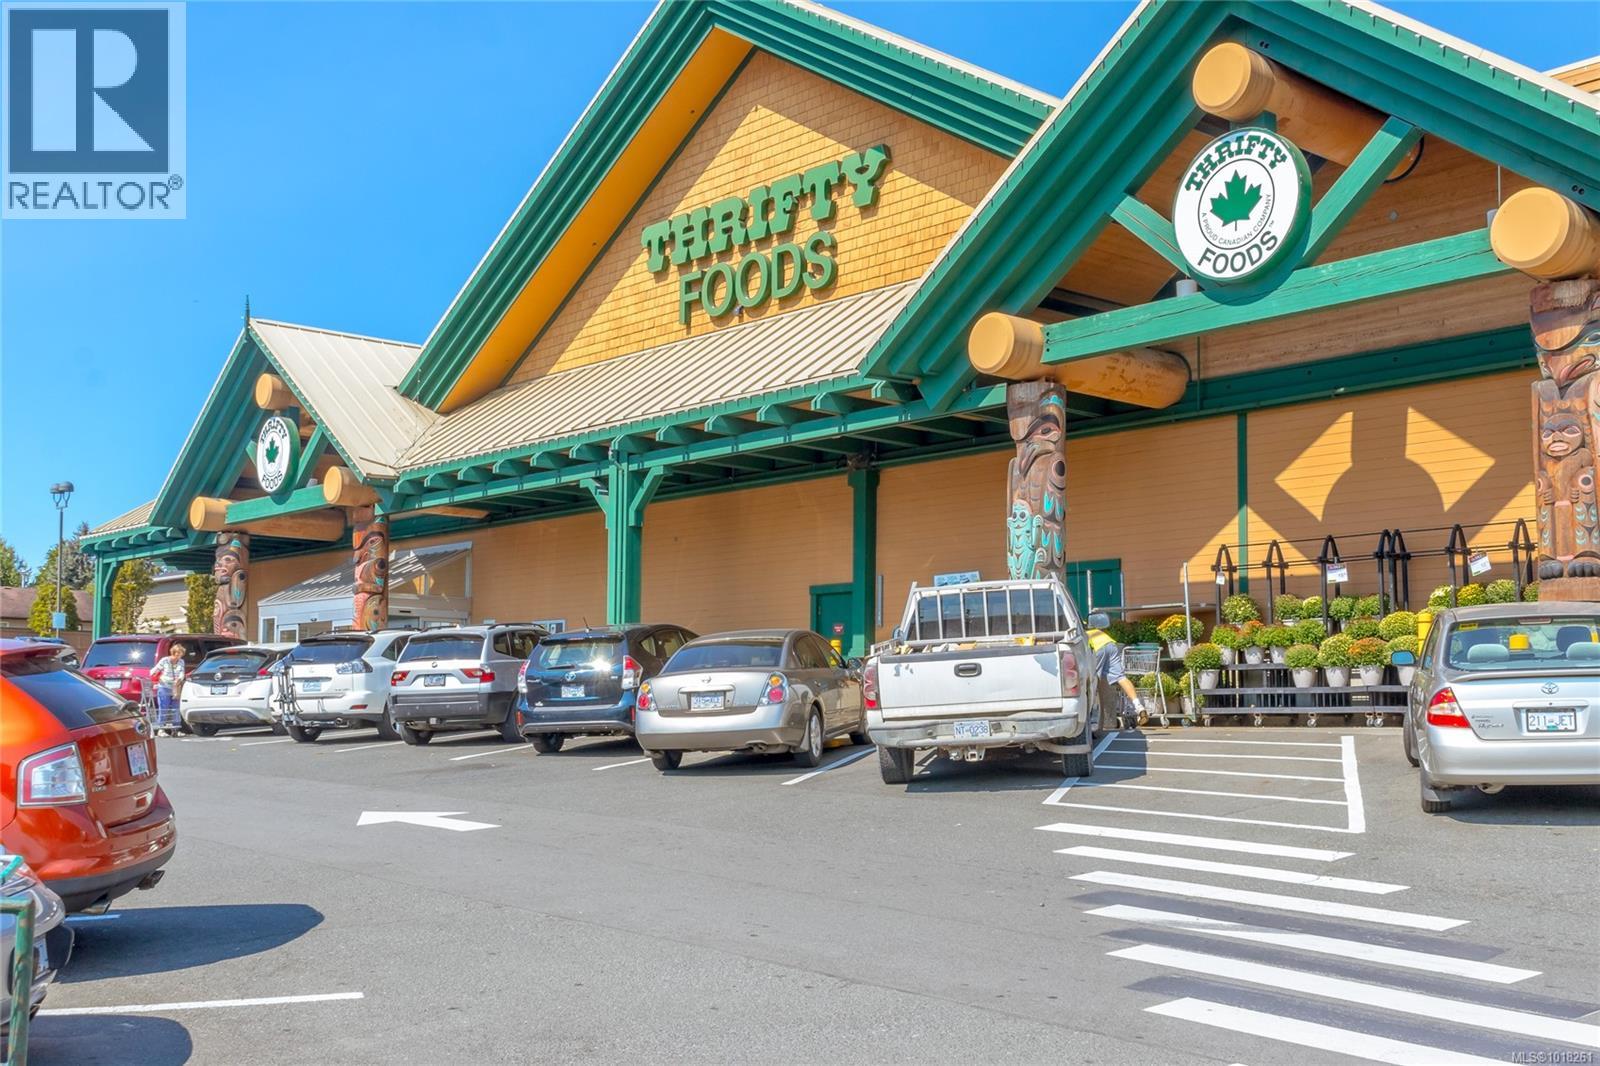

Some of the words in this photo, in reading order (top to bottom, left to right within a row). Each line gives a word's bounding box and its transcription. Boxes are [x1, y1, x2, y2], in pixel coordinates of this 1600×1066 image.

[1184, 134, 1288, 192] THRIFTY
[640, 143, 892, 274] THRIFTY
[1203, 219, 1219, 241] PROUD
[1218, 231, 1253, 246] CANADIAN
[1252, 193, 1272, 233] COMPANY
[678, 230, 838, 326] FOODS
[1197, 230, 1279, 275] FOODS
